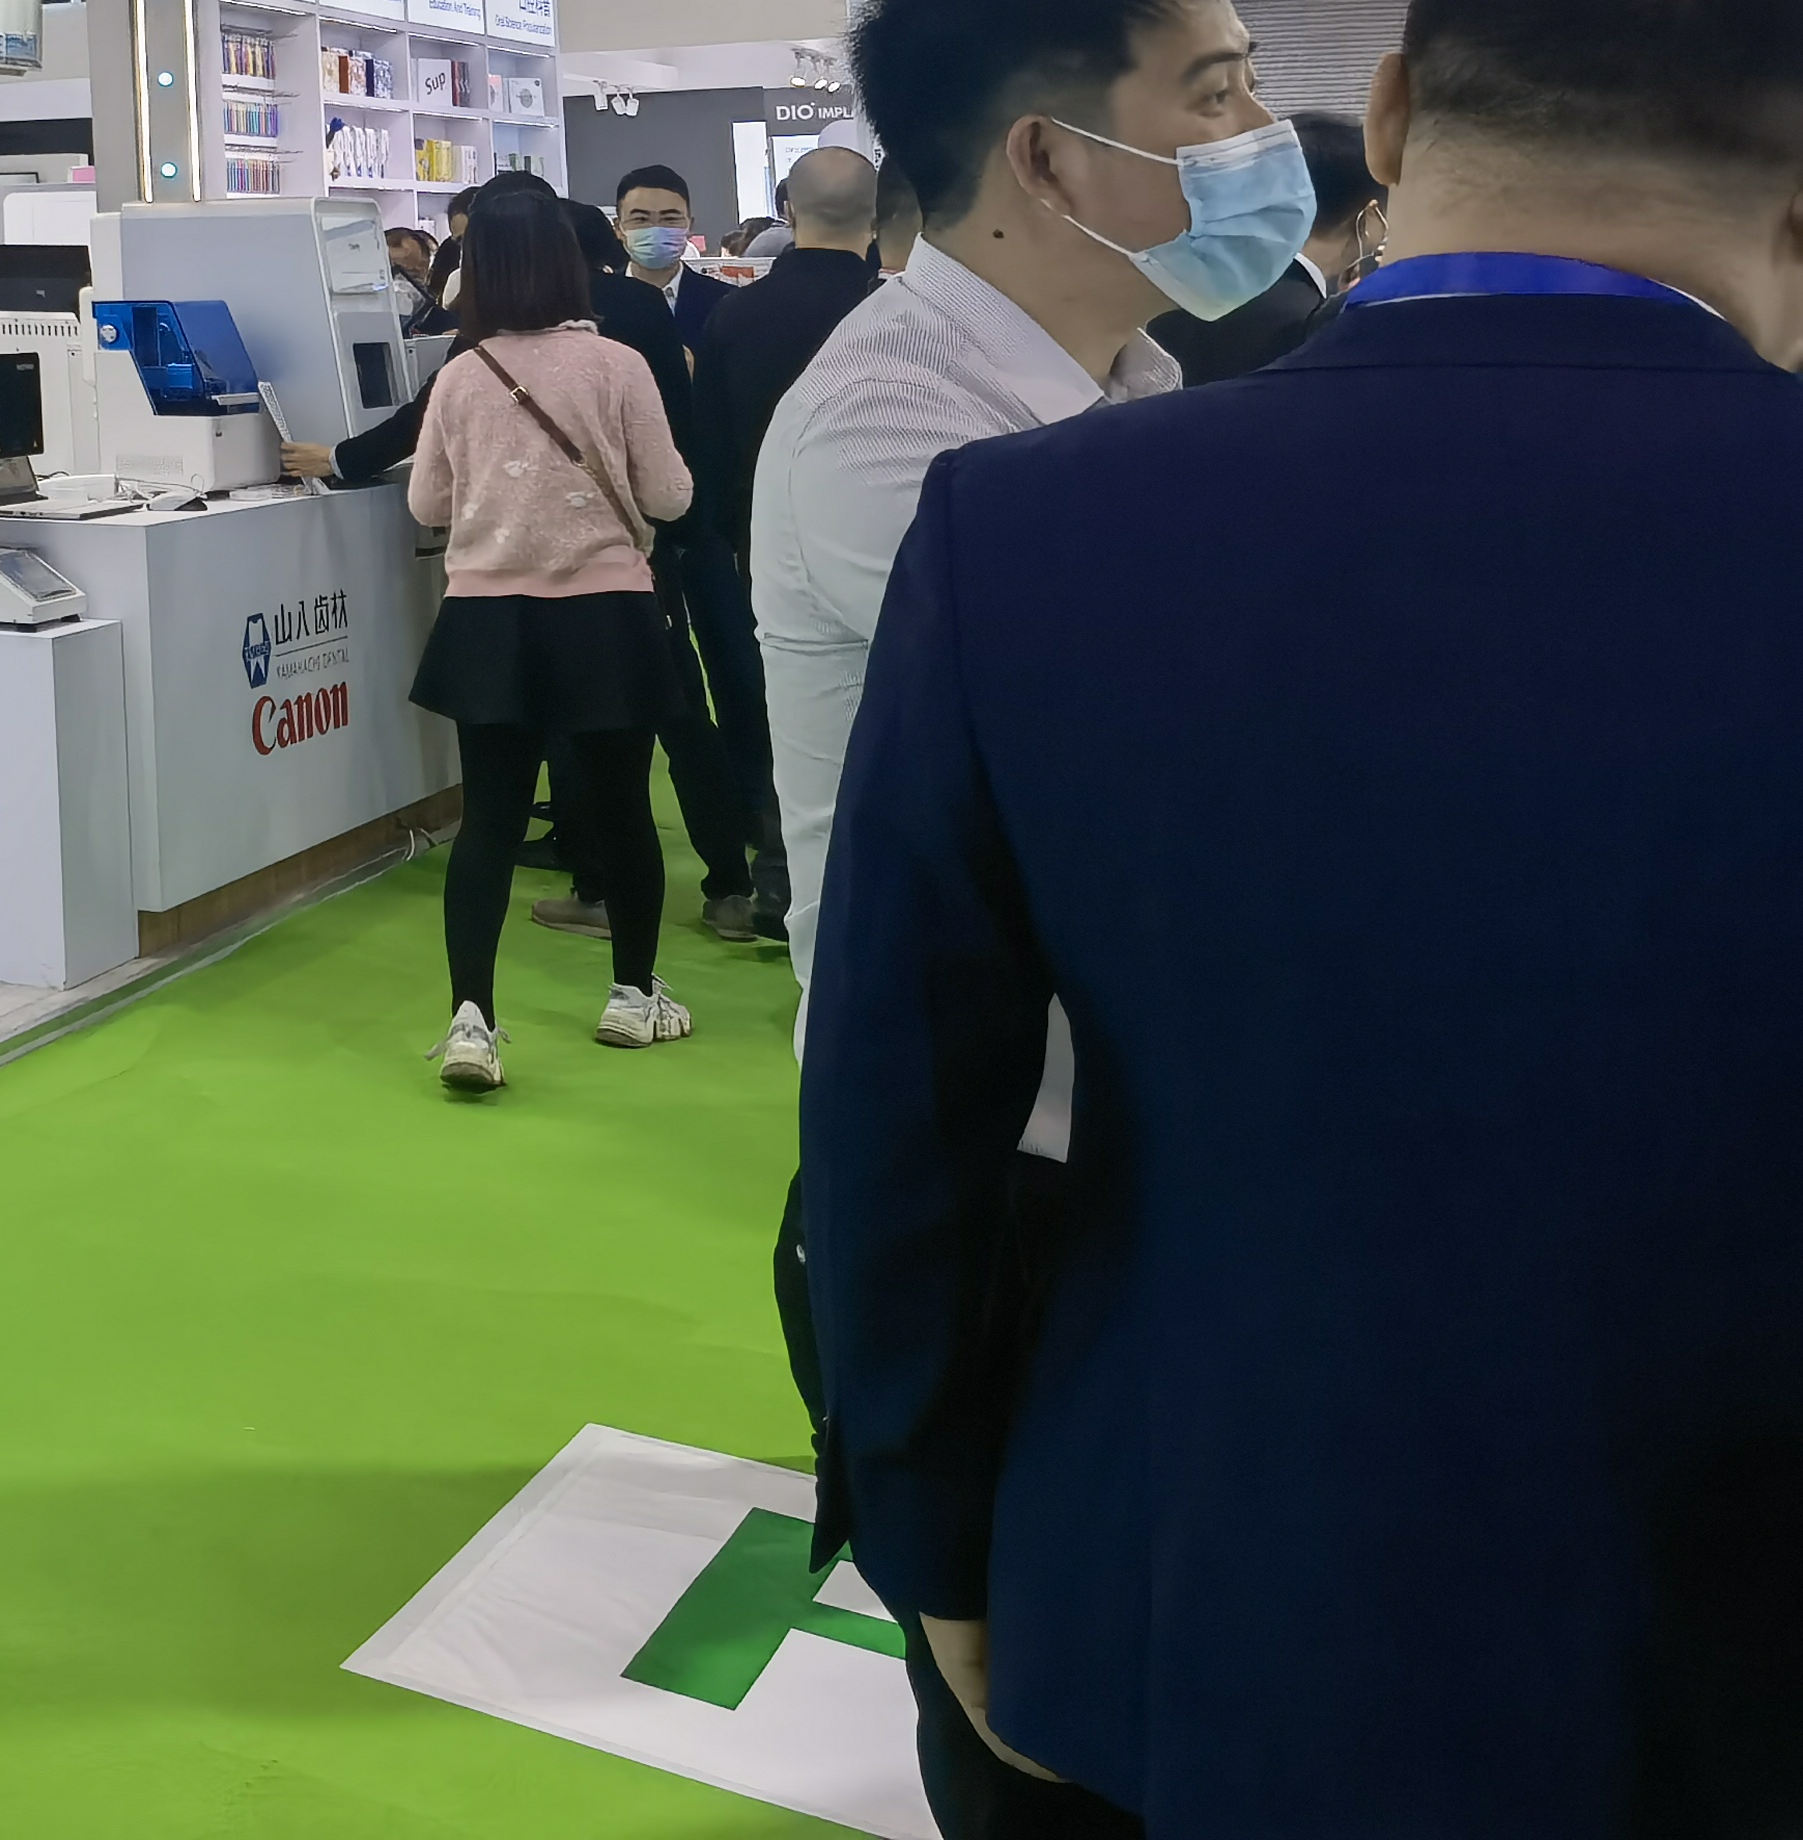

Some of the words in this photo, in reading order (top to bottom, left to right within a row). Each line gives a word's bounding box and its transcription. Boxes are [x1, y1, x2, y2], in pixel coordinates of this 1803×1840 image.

[424, 70, 447, 96] Sup
[776, 102, 815, 121] DIO
[252, 681, 349, 756] Canon
